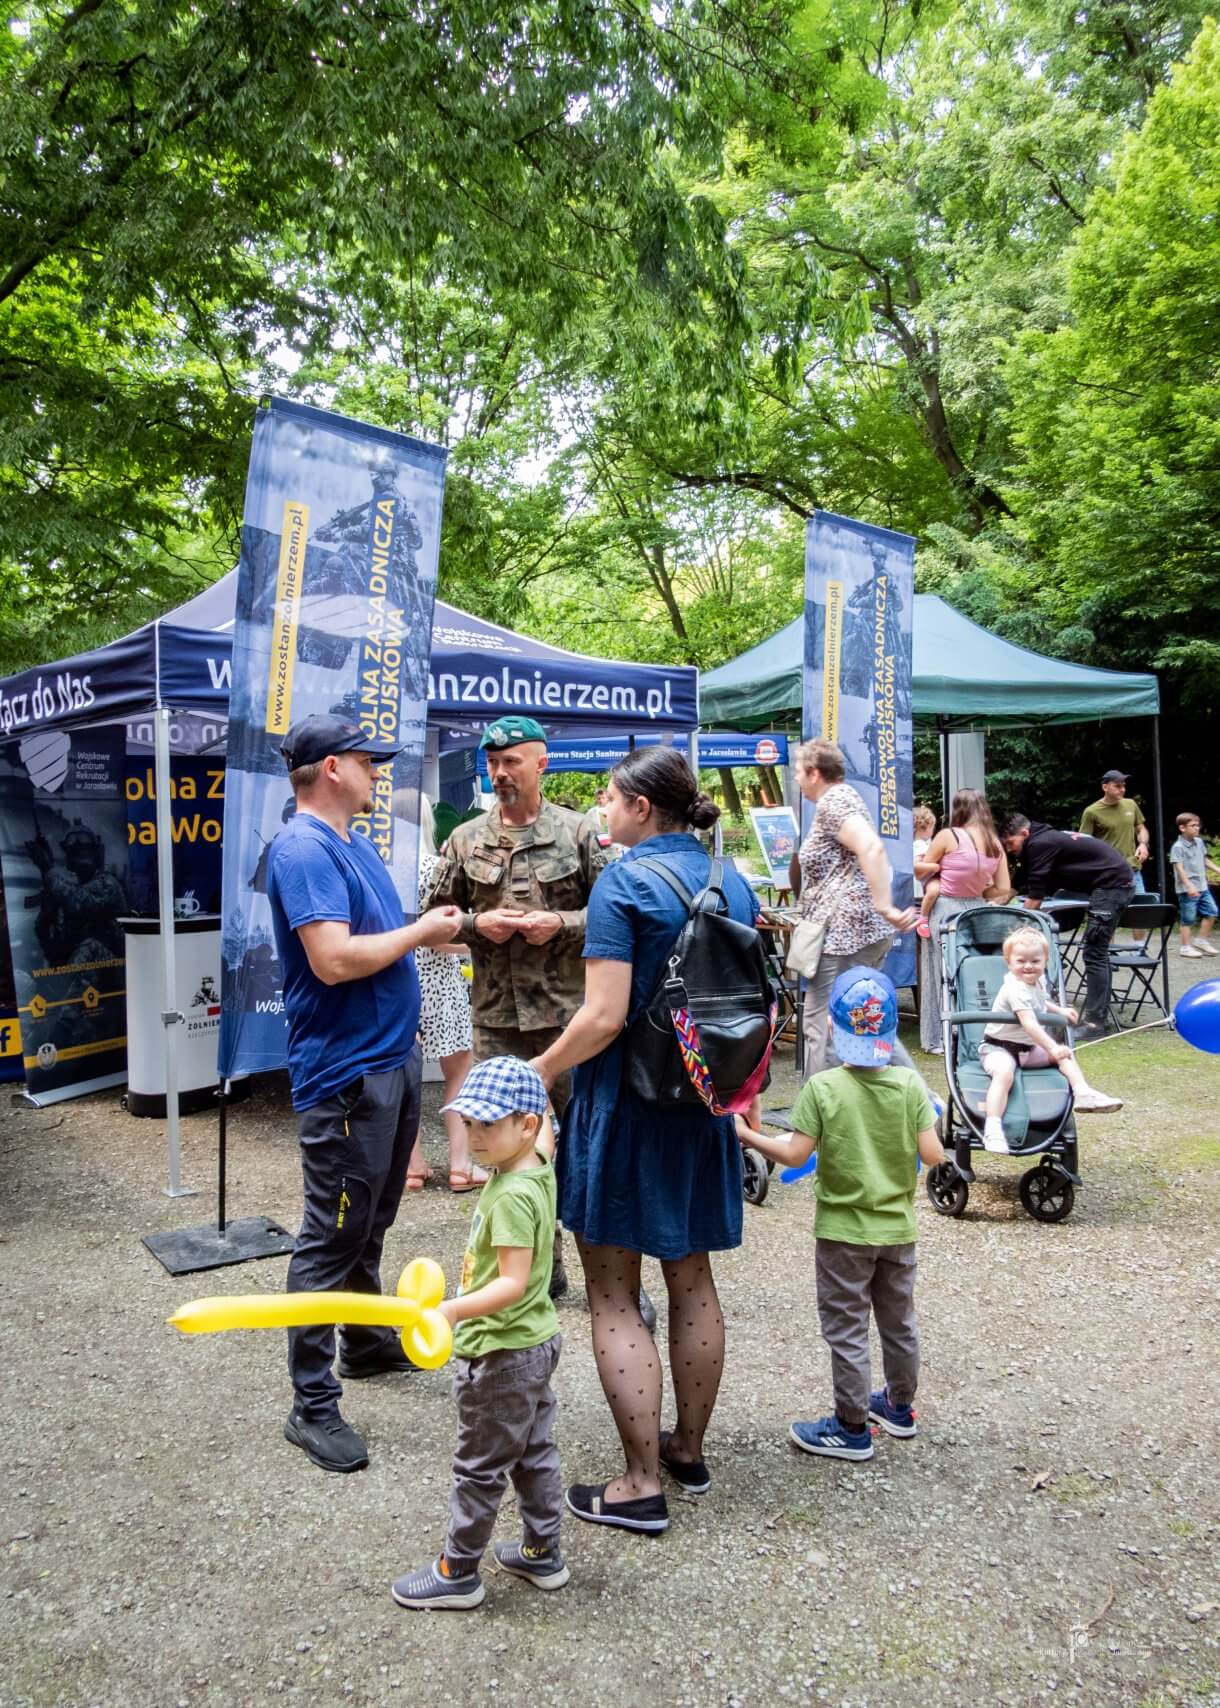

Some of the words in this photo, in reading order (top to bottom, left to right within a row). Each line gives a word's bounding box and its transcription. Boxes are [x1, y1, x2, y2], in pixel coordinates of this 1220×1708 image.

[273, 509, 303, 728] www.zostanzolnierzem.pl
[364, 499, 396, 664] ZASADNICZA
[874, 575, 887, 695] ZASADNICZA
[32, 676, 55, 720] do
[57, 672, 95, 713] Nas
[828, 586, 840, 741] www.zostanzolnierzem.pl
[885, 655, 896, 761] WOJSKOWA
[876, 699, 891, 835] DOBROWOLNA
